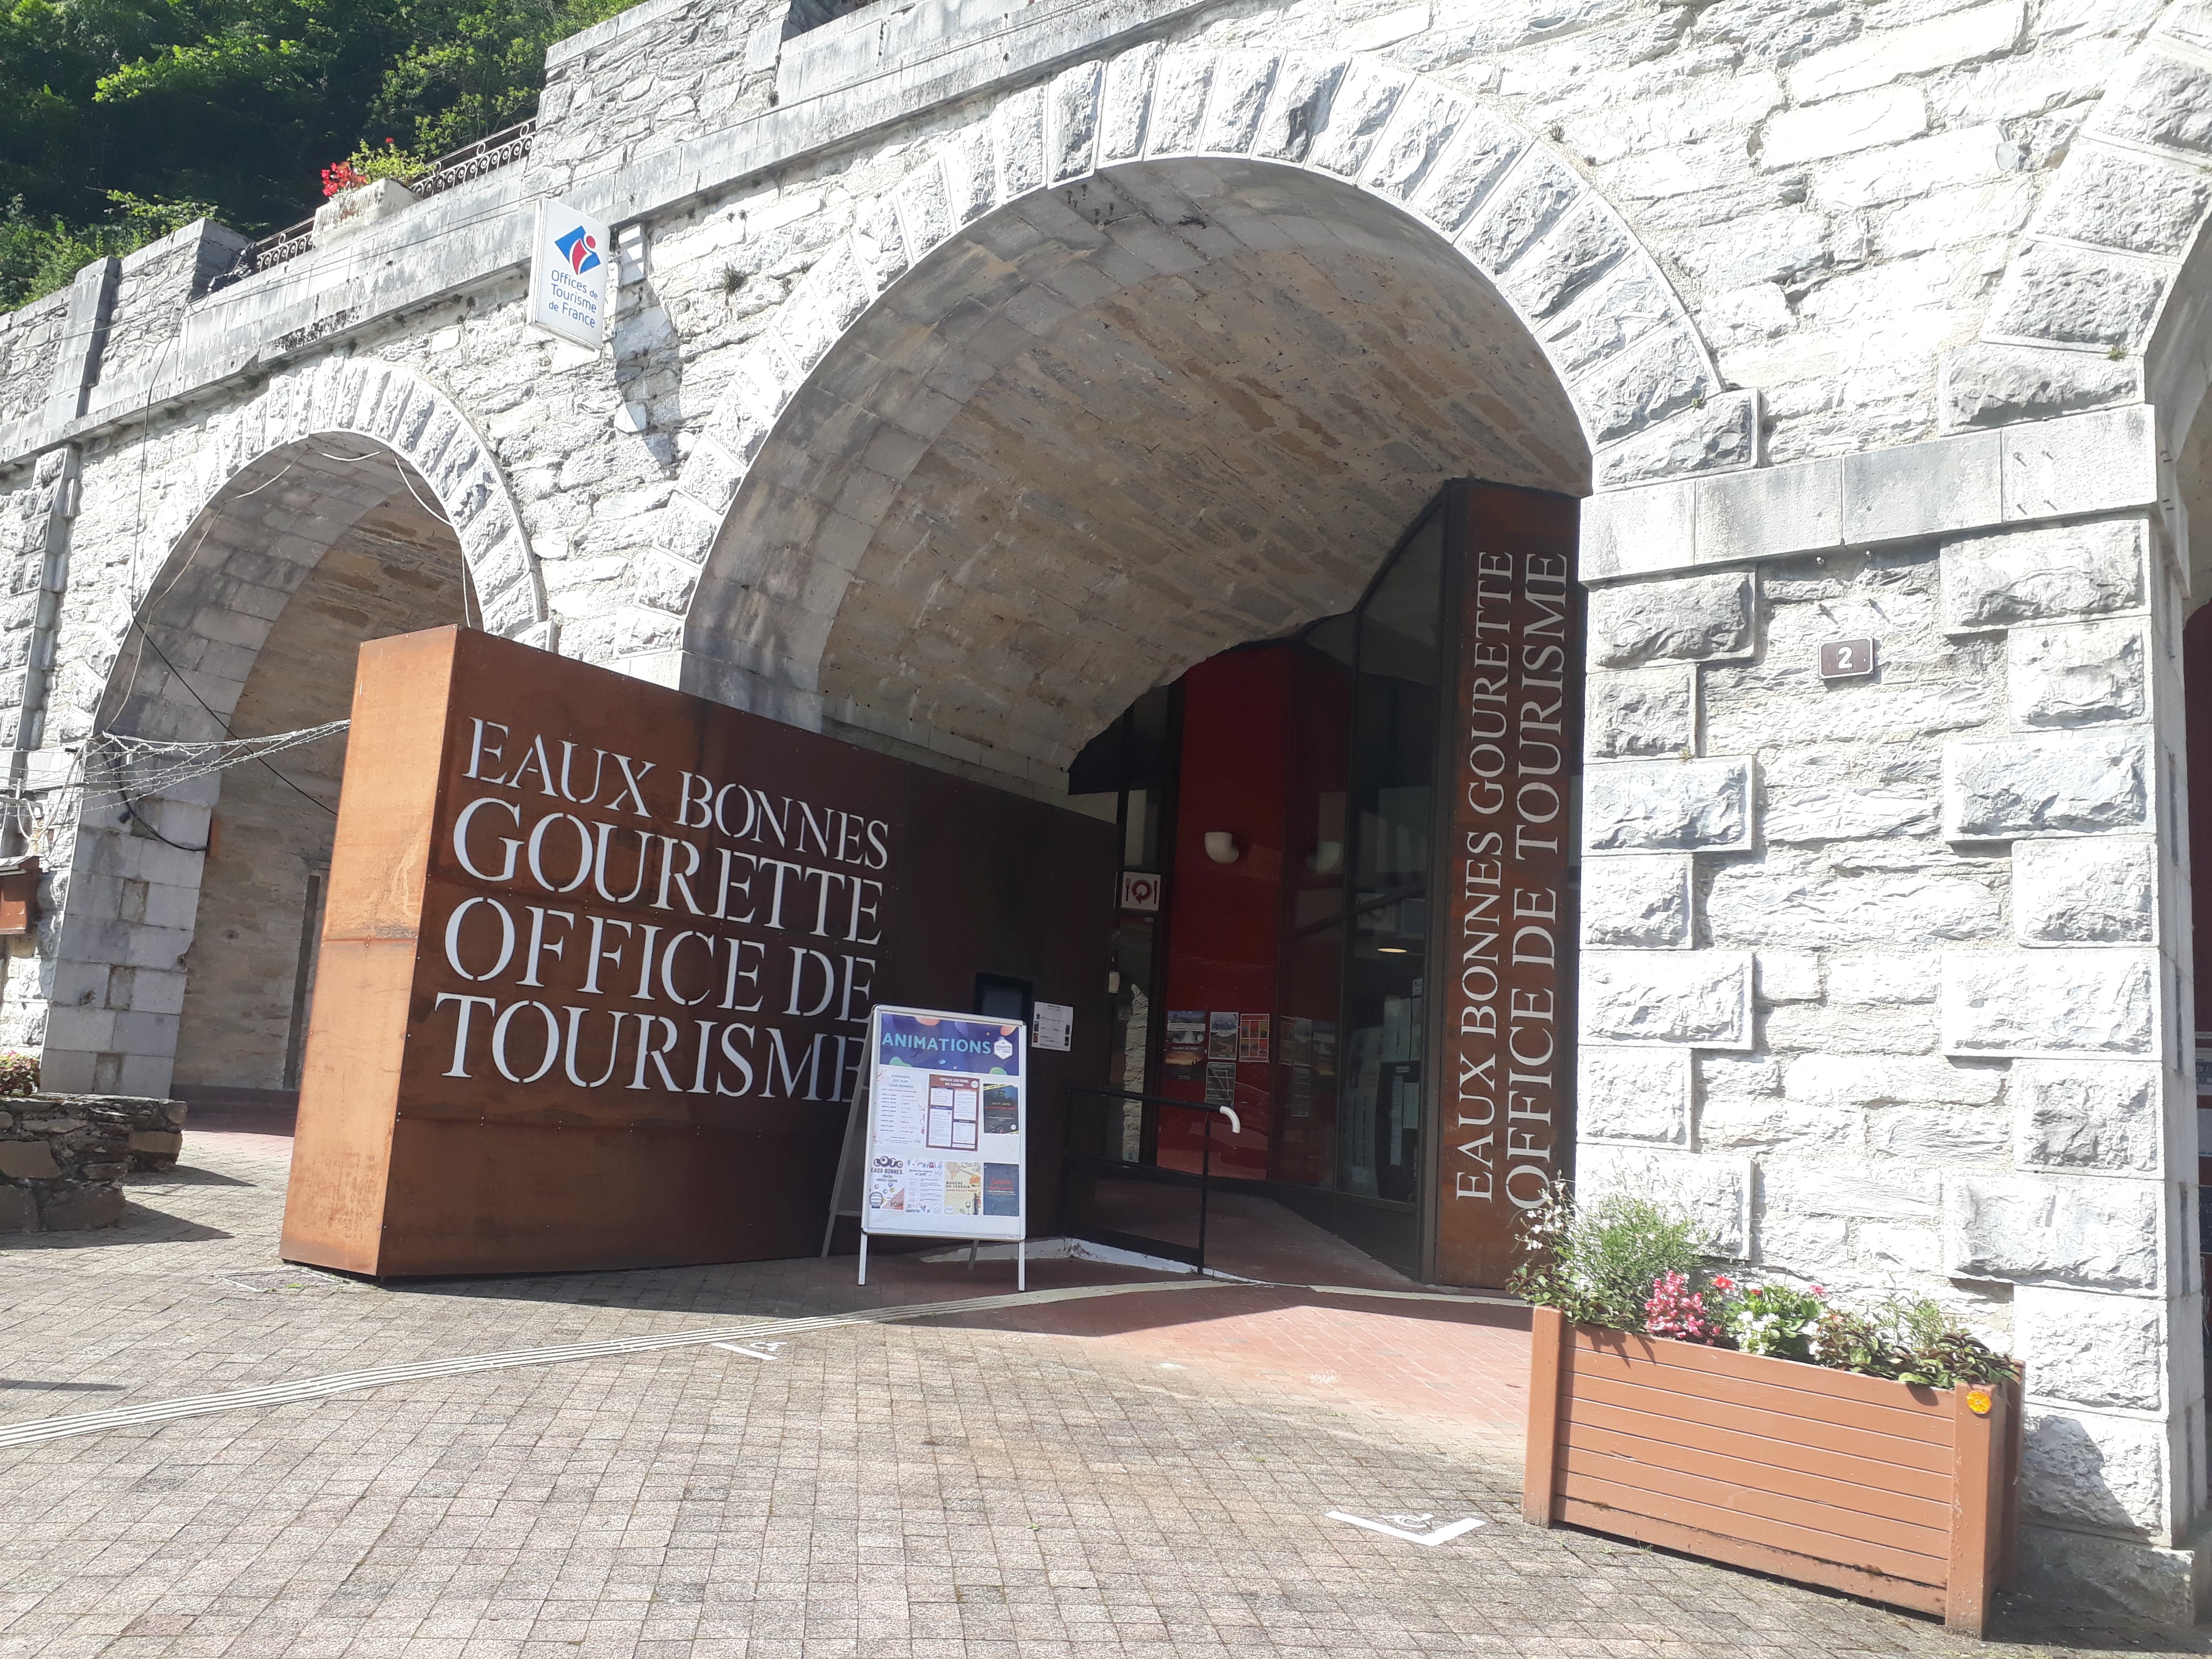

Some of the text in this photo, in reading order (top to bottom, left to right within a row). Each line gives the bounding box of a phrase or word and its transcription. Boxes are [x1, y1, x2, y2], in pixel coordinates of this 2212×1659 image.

[548, 301, 595, 328] de France
[551, 270, 597, 300] Offices de
[551, 283, 596, 313] Tourisme
[1837, 646, 1853, 669] 2
[461, 716, 889, 870] EAUX BONNES
[453, 796, 883, 946] GOURETTE
[1456, 551, 1514, 1204] EAUX BONNES GOURETTE
[1506, 553, 1568, 1209] OFFICE DE TOURISME
[444, 896, 876, 1023] OFFICE DE
[435, 992, 866, 1103] TOURISME
[881, 1032, 991, 1055] ANIMATIONS
[873, 1156, 903, 1168] LOTO
